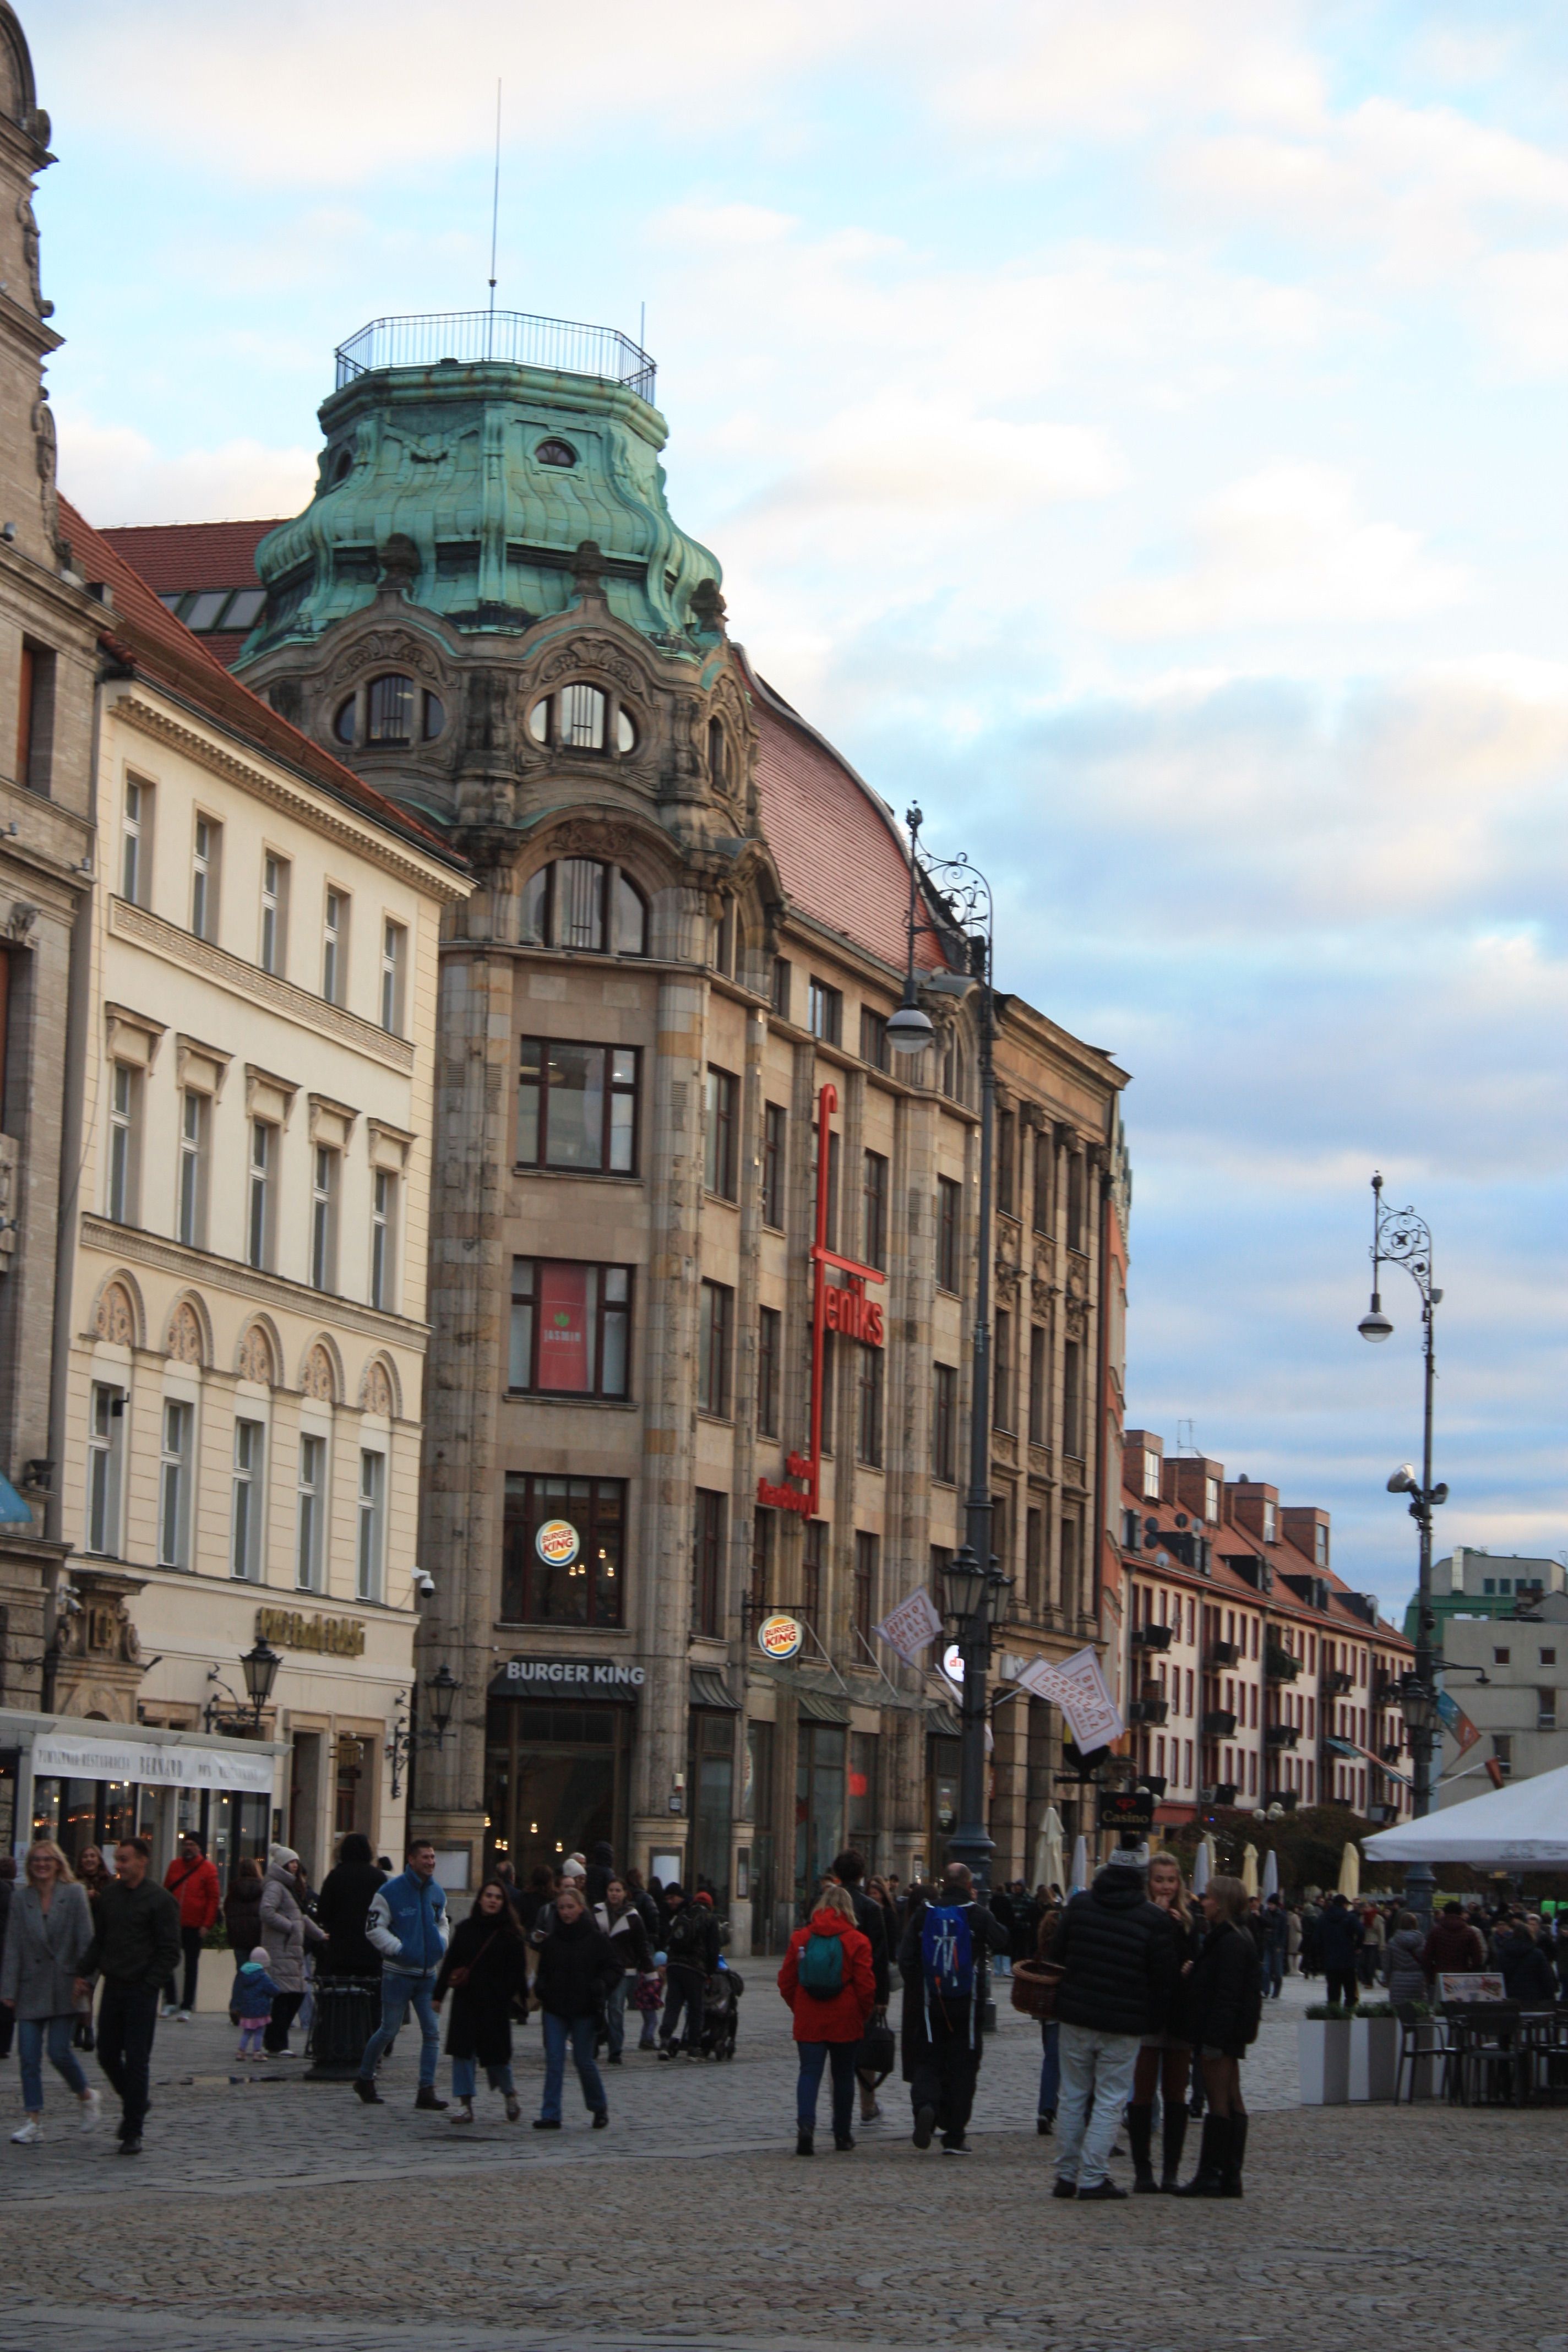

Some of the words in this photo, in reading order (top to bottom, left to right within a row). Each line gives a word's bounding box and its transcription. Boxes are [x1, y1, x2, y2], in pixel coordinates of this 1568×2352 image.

[542, 1529, 571, 1543] BURGER
[543, 1537, 573, 1554] KING
[765, 1624, 796, 1637] BURGER
[766, 1631, 796, 1648] KING
[507, 1662, 589, 1682] BURGER
[593, 1665, 645, 1685] KING
[1102, 1810, 1149, 1824] Casino
